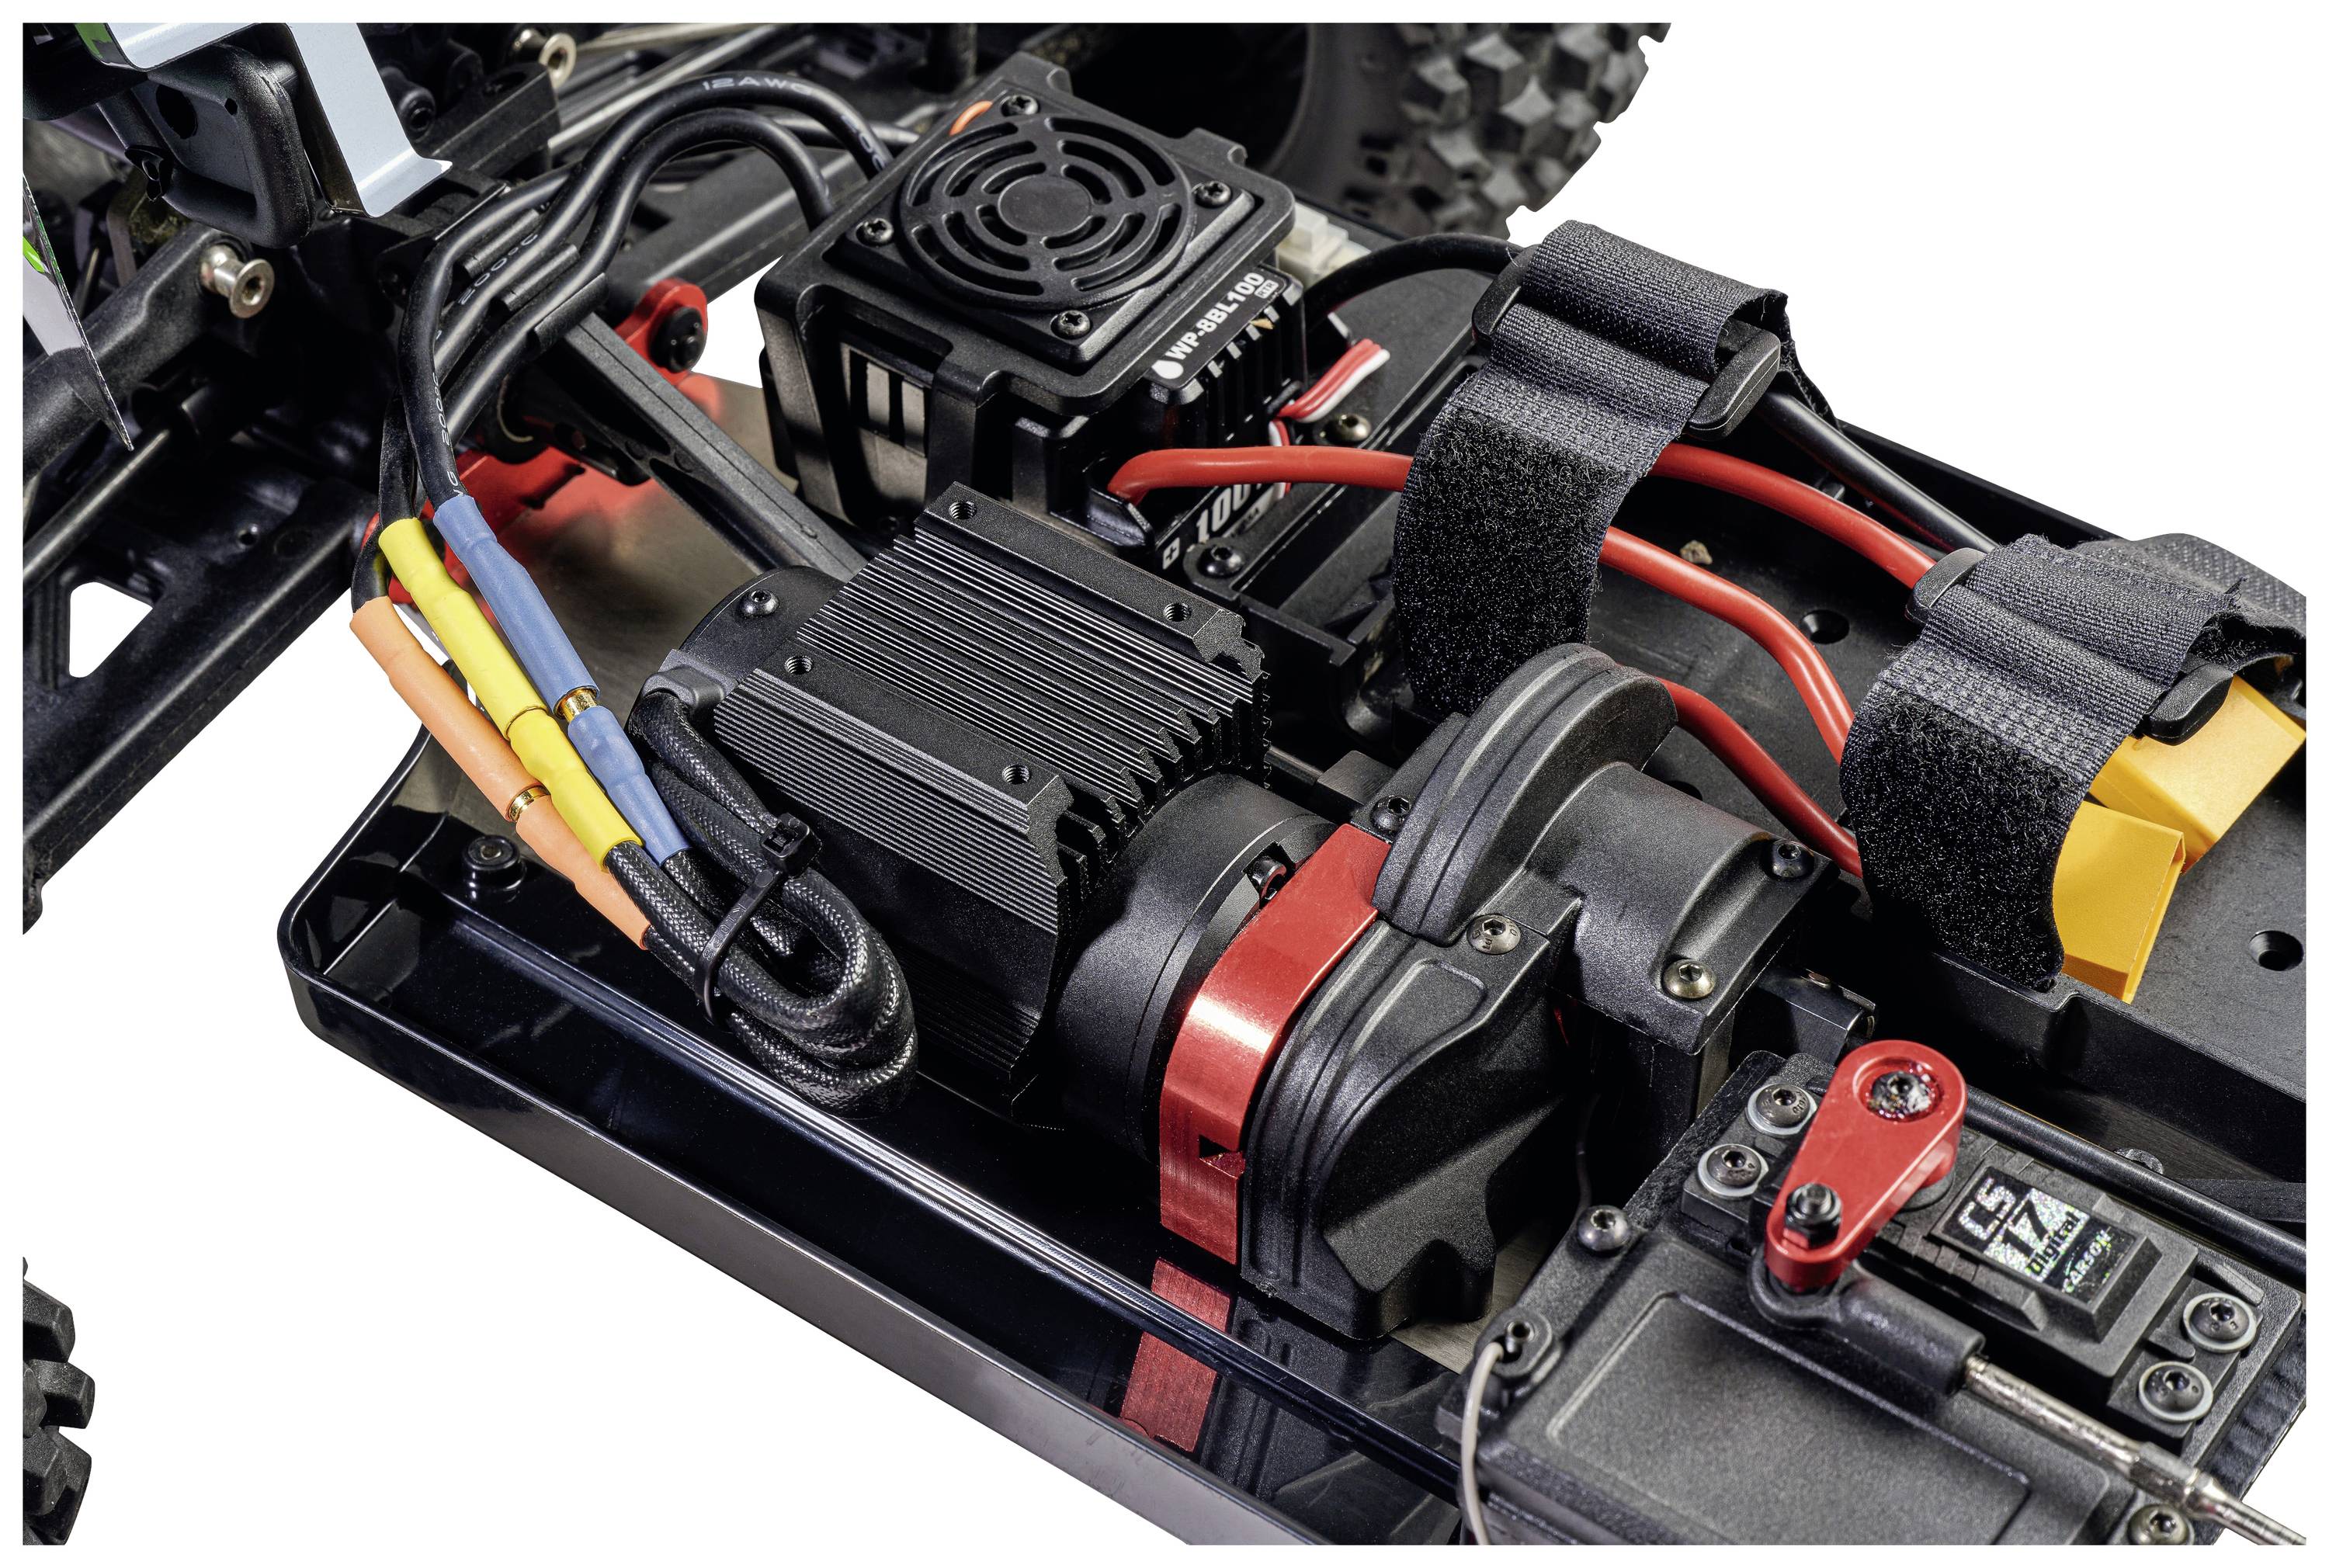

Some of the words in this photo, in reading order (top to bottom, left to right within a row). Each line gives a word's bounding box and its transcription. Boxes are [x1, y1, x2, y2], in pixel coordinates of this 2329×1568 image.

[1164, 272, 1265, 360] WP-8BL100
[1957, 1177, 2017, 1240] CS
[2001, 1201, 2049, 1257] 17
[2028, 1212, 2081, 1275] Digital
[2063, 1229, 2112, 1293] CARSON
